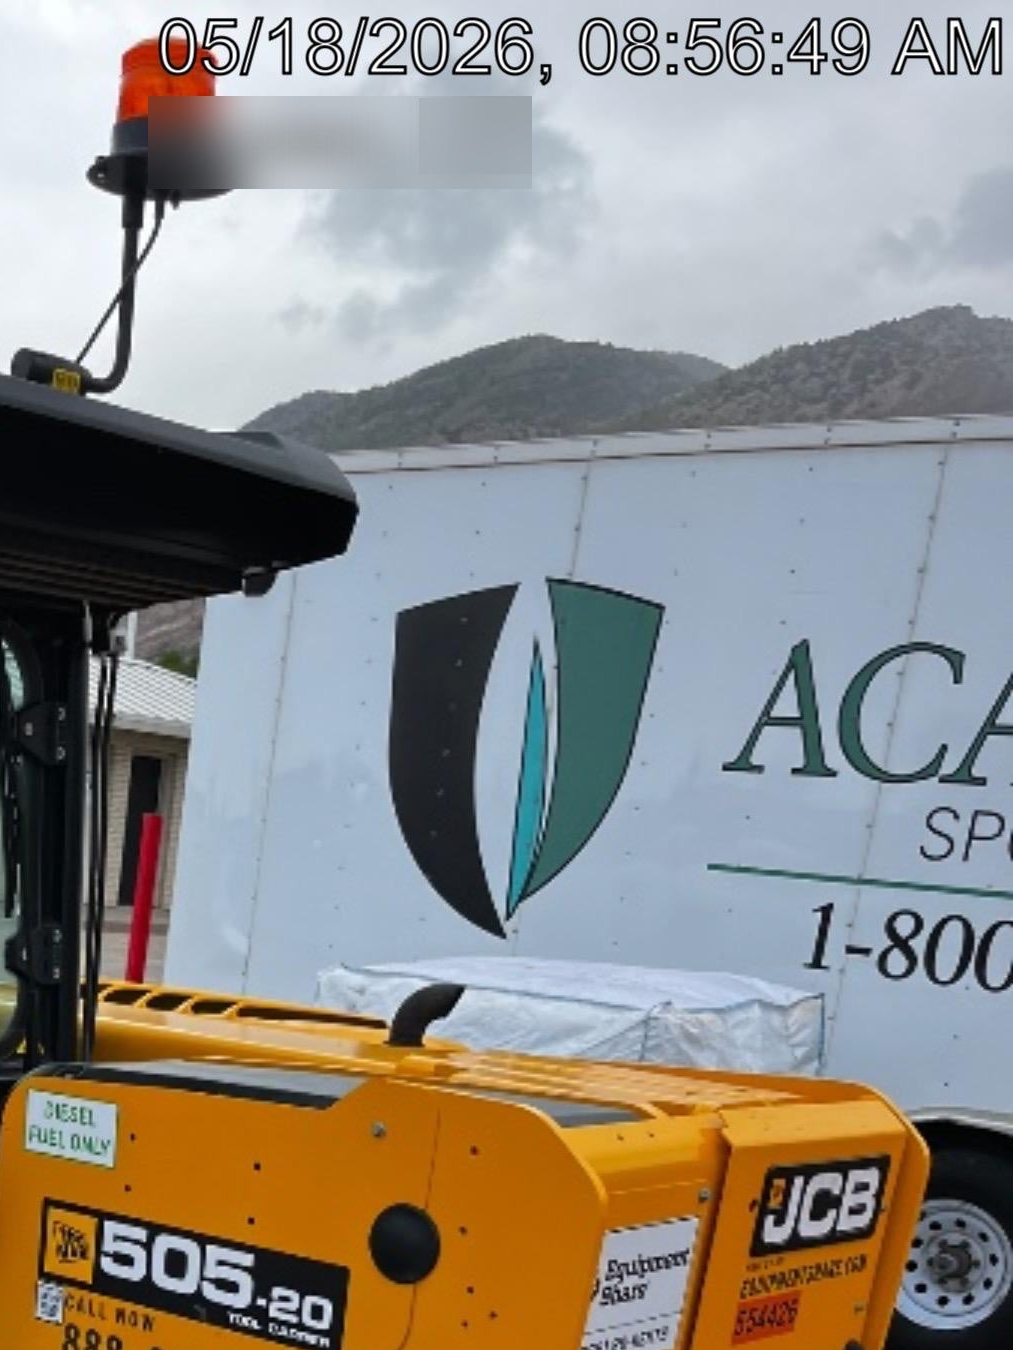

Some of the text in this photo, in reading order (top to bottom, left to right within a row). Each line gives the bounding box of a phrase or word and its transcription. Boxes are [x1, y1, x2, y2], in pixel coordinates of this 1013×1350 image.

[721, 638, 1013, 786] ACA
[919, 805, 1013, 862] SP
[803, 902, 1013, 993] 1-800
[29, 1124, 111, 1156] FUEL ONLY
[44, 1100, 95, 1127] DIESEL
[762, 1166, 881, 1245] JCB
[64, 1292, 155, 1332] CALL NOW
